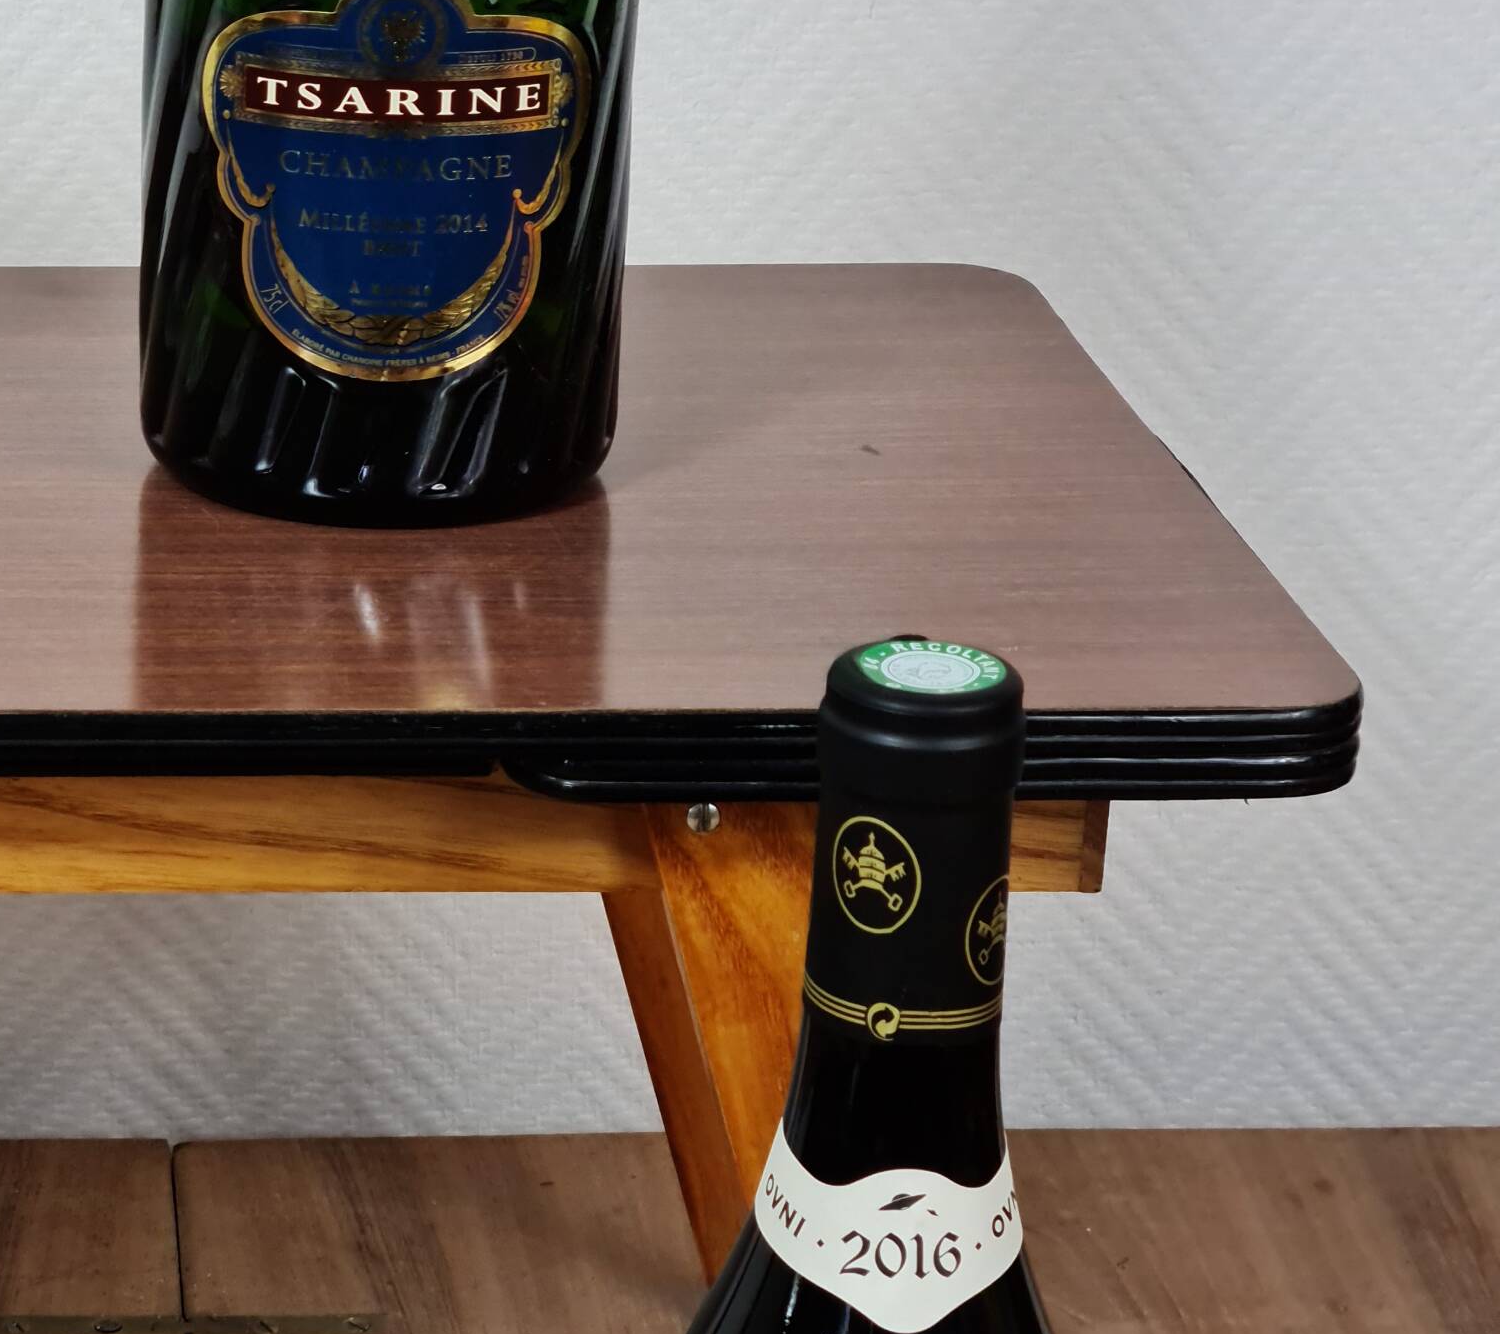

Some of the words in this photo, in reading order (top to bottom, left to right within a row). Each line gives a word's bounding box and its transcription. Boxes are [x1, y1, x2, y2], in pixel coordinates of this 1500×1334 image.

[257, 76, 541, 116] TSARINE
[279, 149, 512, 181] CHAMPAGNE
[435, 213, 489, 234] 2014
[890, 642, 1000, 680] RECOLTANT
[765, 1173, 806, 1238] OVNI
[839, 1230, 962, 1279] 2016
